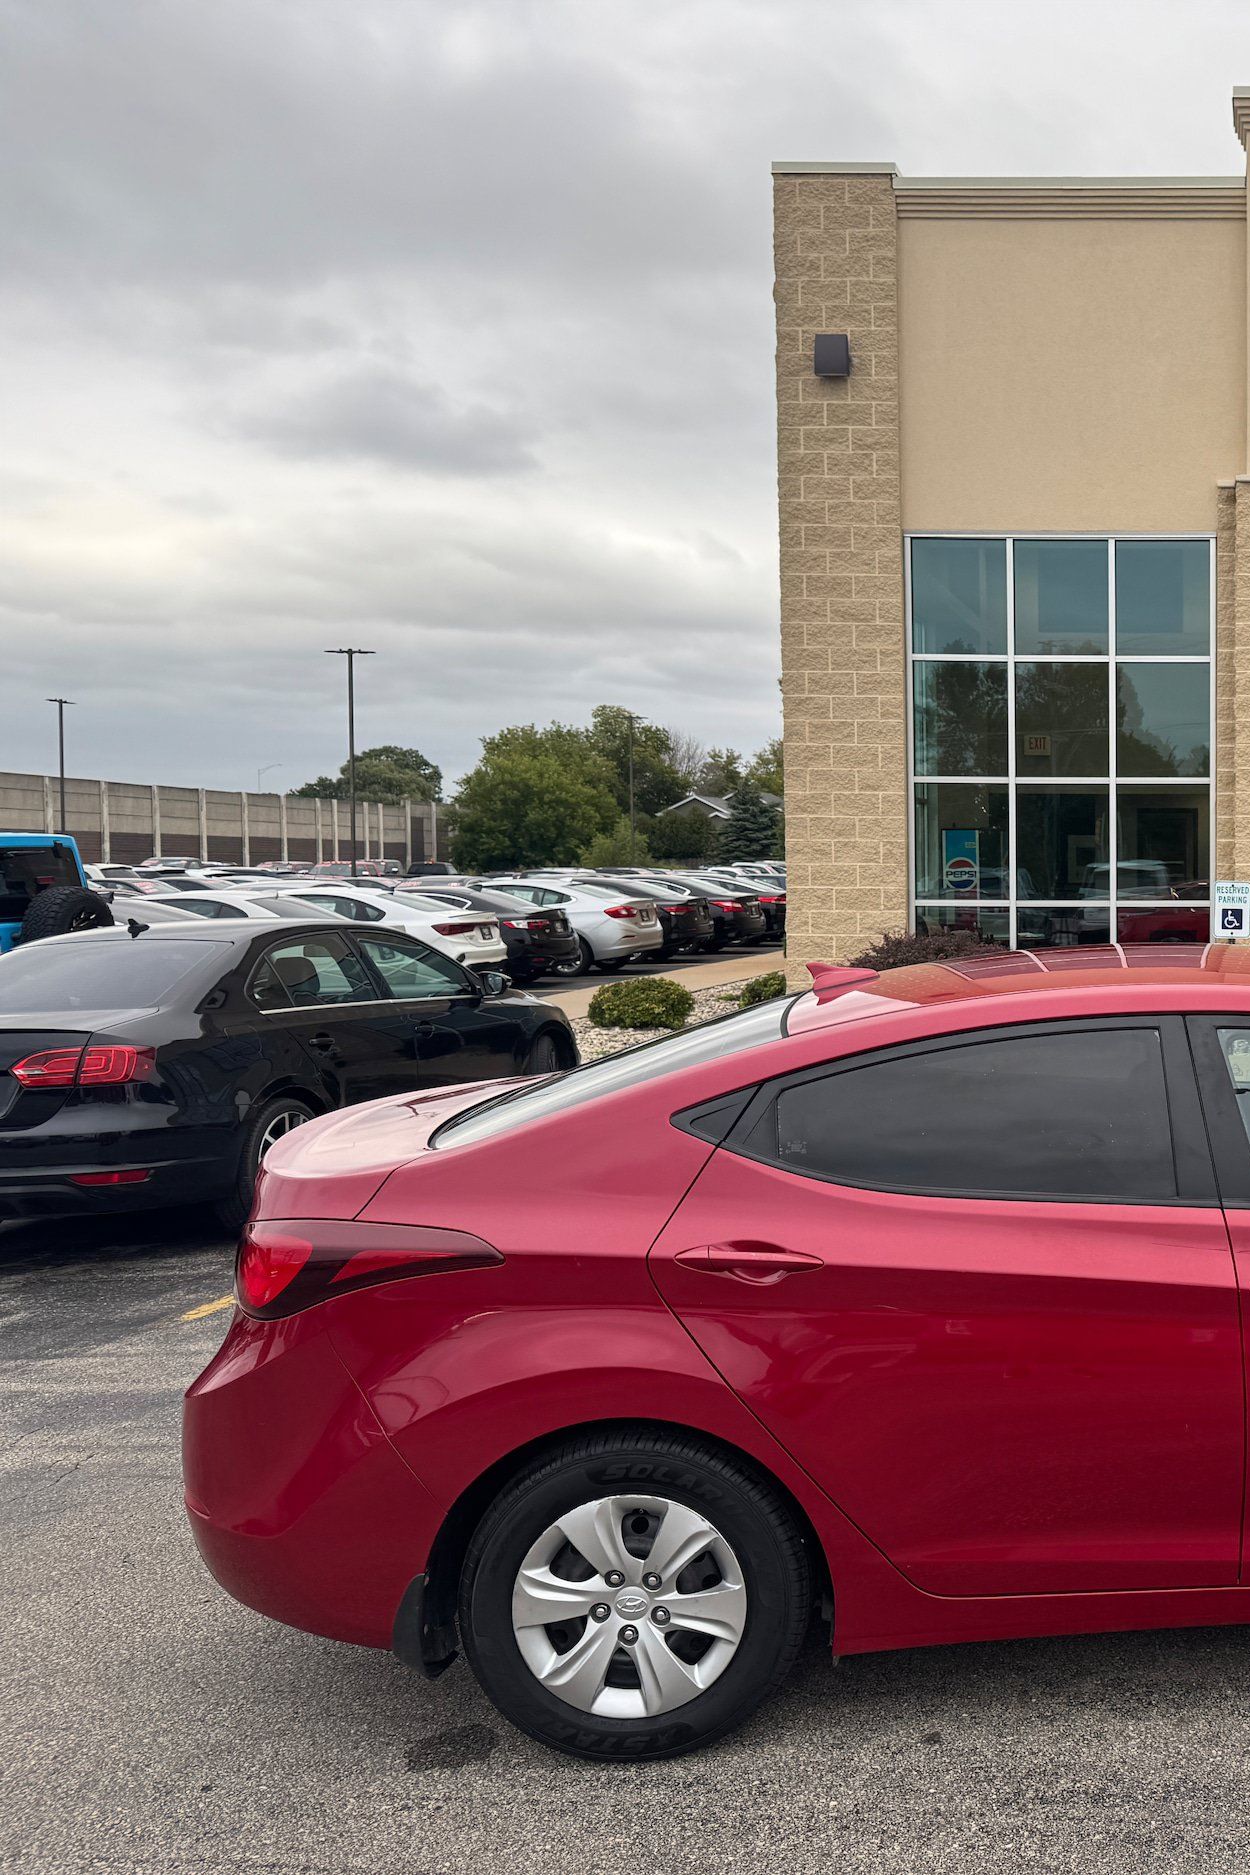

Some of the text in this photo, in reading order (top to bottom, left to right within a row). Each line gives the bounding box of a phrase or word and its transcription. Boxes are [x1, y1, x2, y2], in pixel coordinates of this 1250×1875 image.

[1029, 736, 1046, 750] EXIT
[946, 870, 977, 879] PEPSI
[1217, 886, 1250, 895] RESERVED
[1218, 896, 1247, 904] PARKING
